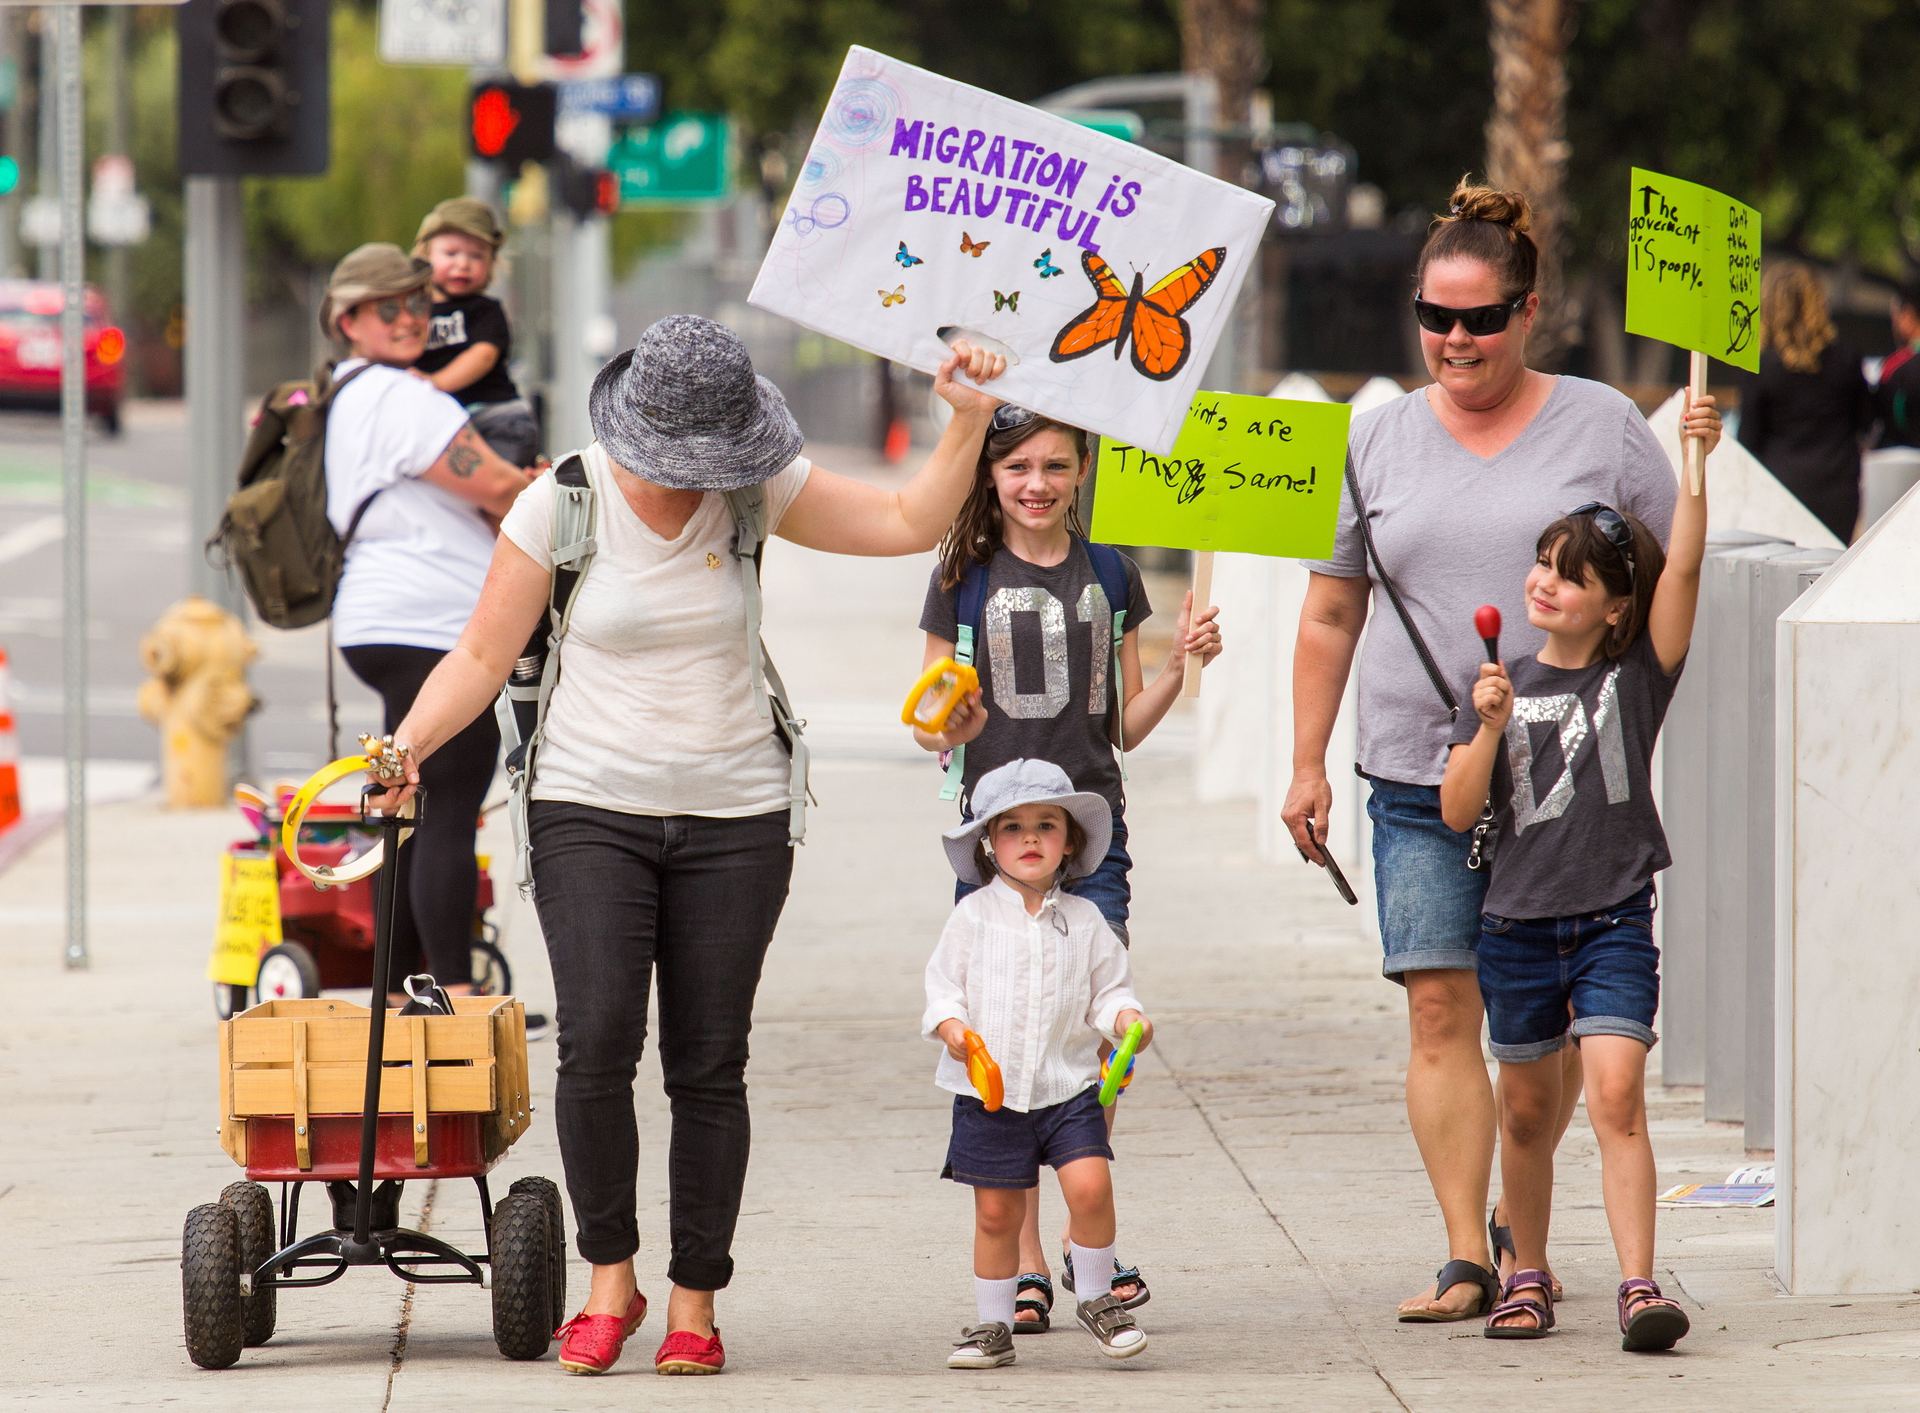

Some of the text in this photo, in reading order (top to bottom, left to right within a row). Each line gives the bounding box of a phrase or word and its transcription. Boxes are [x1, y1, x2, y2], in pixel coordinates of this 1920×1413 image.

[1638, 185, 1678, 222] The
[1659, 259, 1703, 291] poopy.
[1189, 401, 1293, 442] ints are
